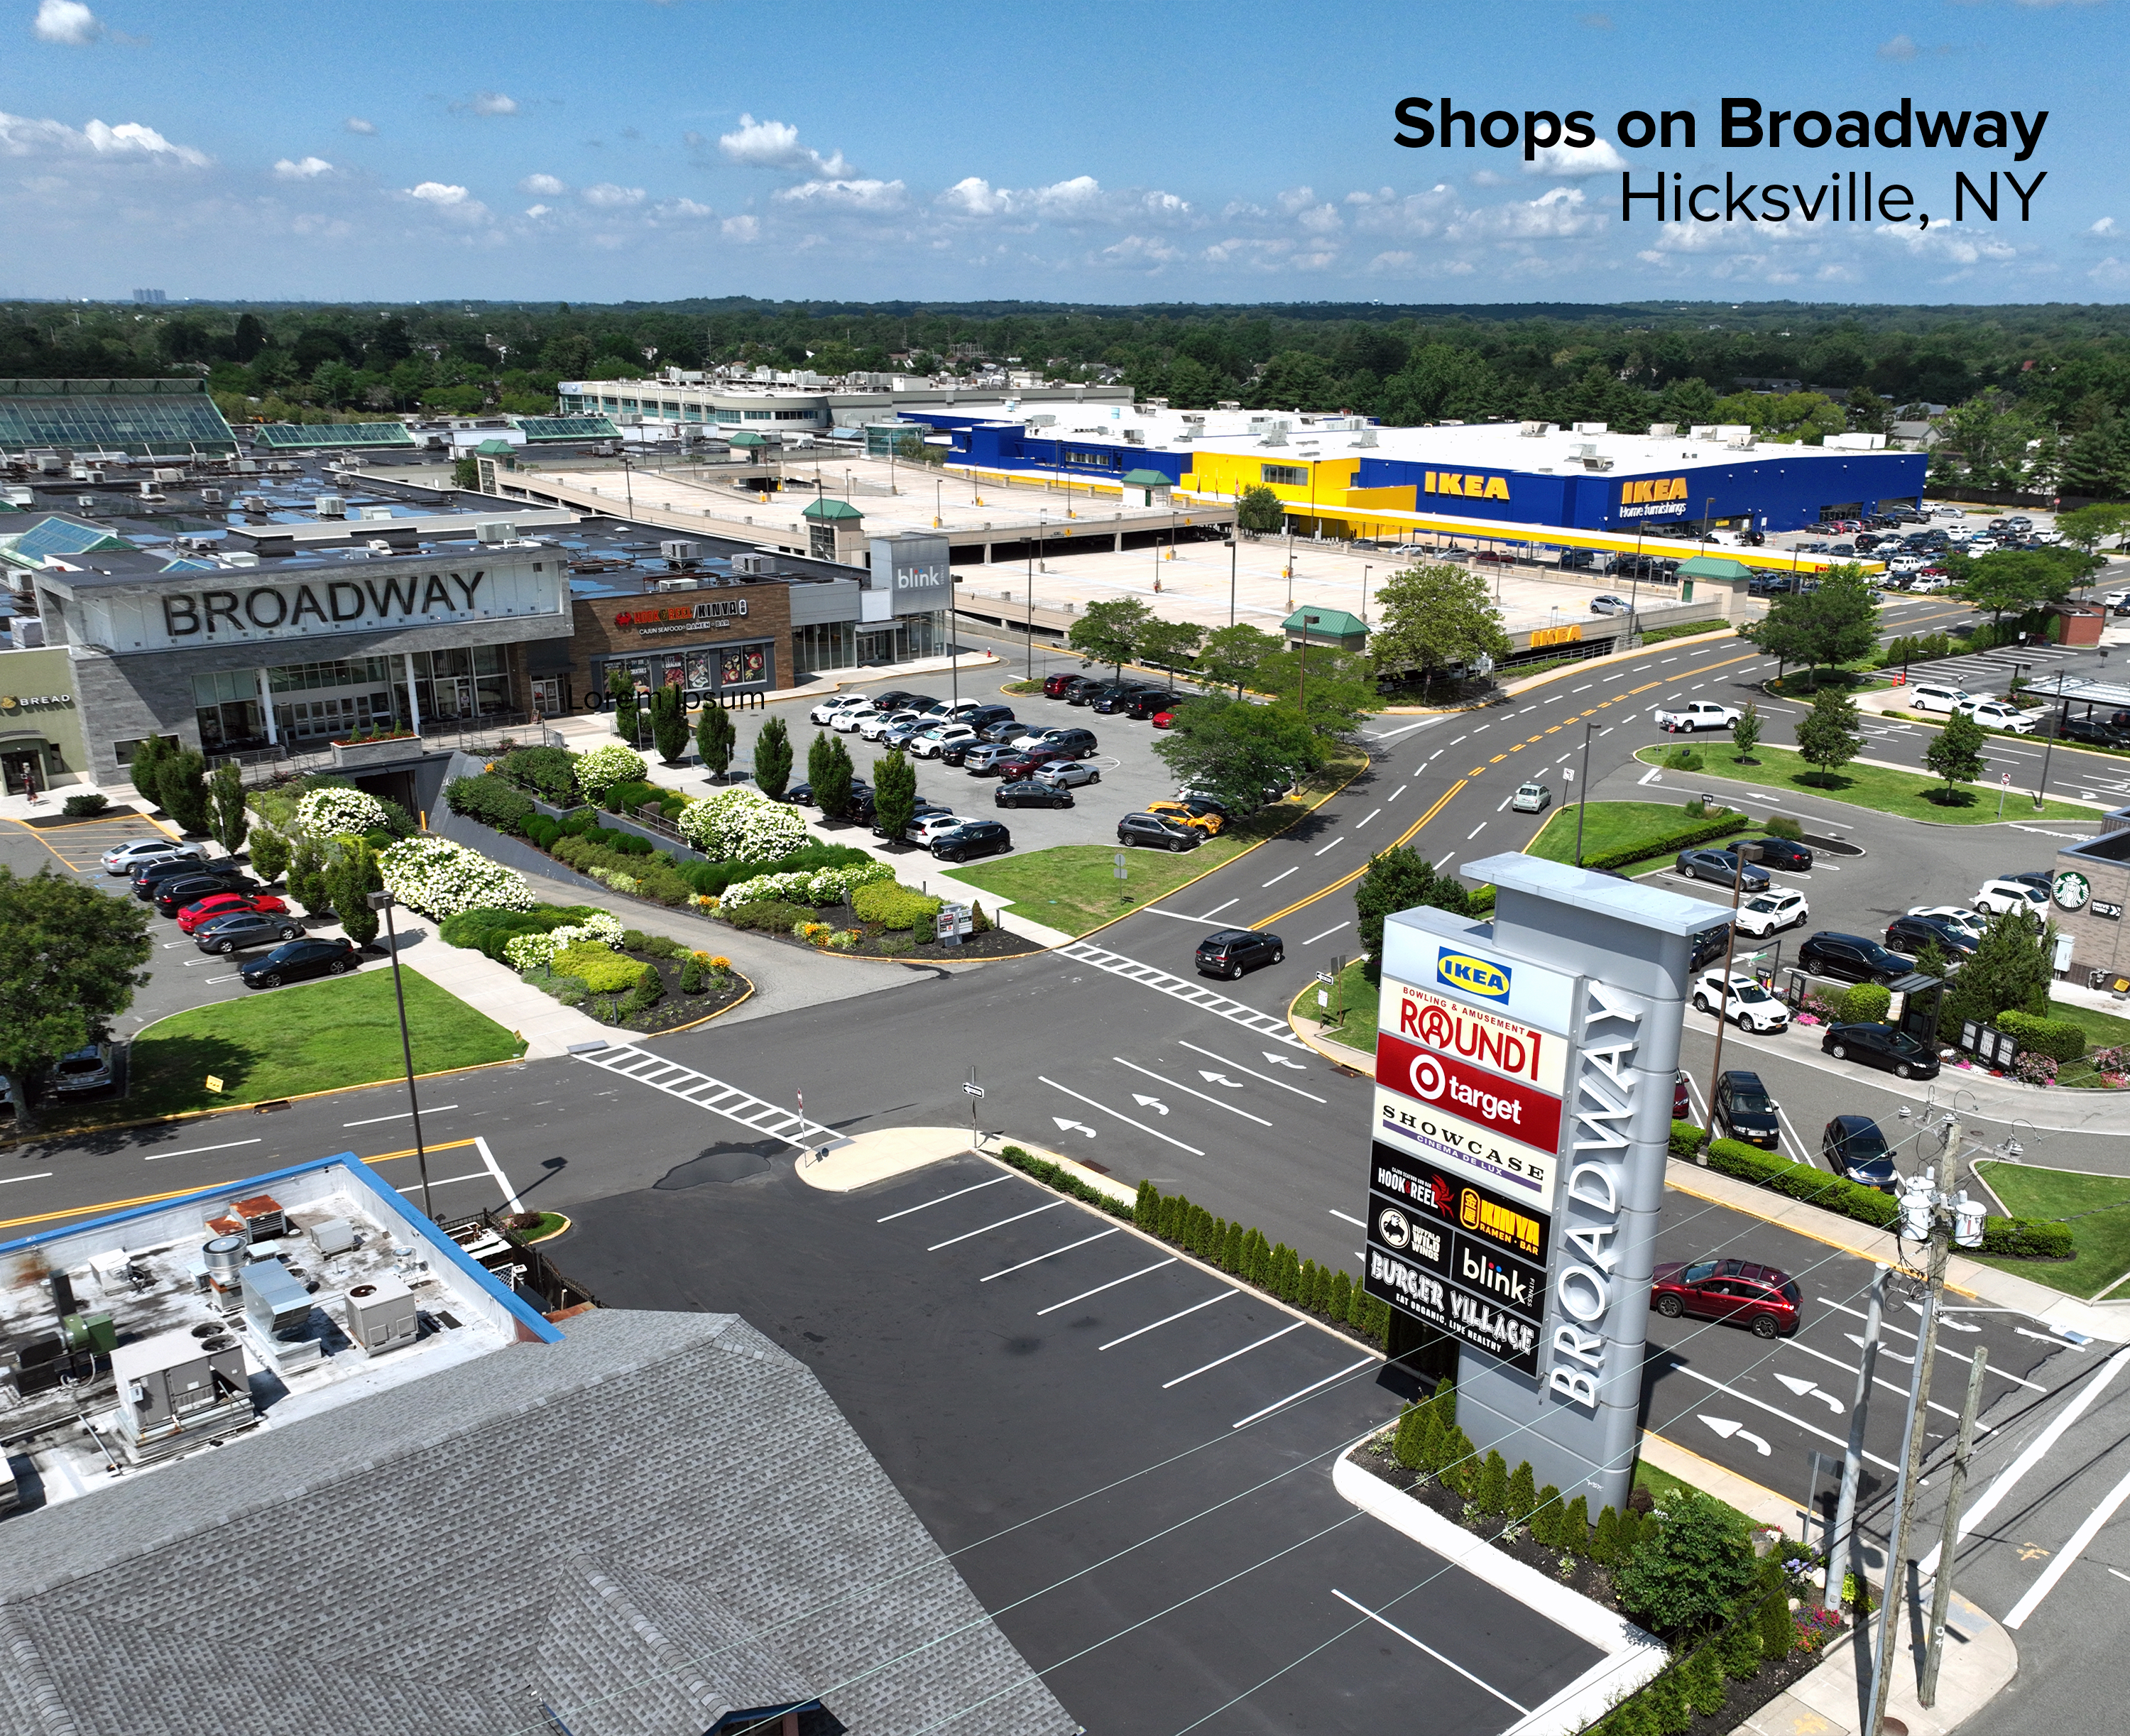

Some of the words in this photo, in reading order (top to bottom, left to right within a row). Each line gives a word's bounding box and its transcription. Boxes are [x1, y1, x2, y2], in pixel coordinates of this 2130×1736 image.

[1424, 471, 1510, 501] IKEA
[1621, 477, 1688, 505] IKEA
[1620, 506, 1644, 518] Home
[1644, 501, 1687, 516] furnishings
[897, 566, 940, 589] blink
[162, 571, 485, 637] BROADWAY
[686, 621, 710, 630] RAMEN
[715, 619, 730, 628] BAR
[1530, 625, 1583, 648] IKEA
[20, 694, 70, 706] BREAD
[2092, 901, 2110, 910] DRIVE
[1444, 959, 1504, 992] IKEA
[1403, 986, 1447, 1008] BOWLING
[1462, 1008, 1525, 1035] AMUSEMENT
[1449, 1076, 1522, 1125] target
[1382, 1104, 1544, 1181] SHOWCASE
[1416, 1135, 1459, 1157] CINEMA
[1462, 1154, 1477, 1165] DE
[1481, 1162, 1503, 1176] LUX
[1392, 1167, 1403, 1176] CAJUN
[1402, 1171, 1418, 1182] SEAFOOD
[1549, 978, 1643, 1410] BROADWAY
[1412, 1224, 1441, 1243] BUFFALO
[1480, 1199, 1540, 1248] KINYA
[1411, 1240, 1439, 1262] WINGS
[1412, 1230, 1441, 1253] WILD
[1480, 1223, 1512, 1244] RAMEN
[1519, 1240, 1539, 1256] BAR
[1463, 1248, 1527, 1304] blink
[1371, 1250, 1445, 1312] BURGER
[1451, 1290, 1534, 1355] VILLAGE
[1526, 1277, 1535, 1308] FITNESS
[1396, 1293, 1409, 1306] EAT
[1449, 1319, 1465, 1335] LIVE
[1468, 1329, 1502, 1353] HEALTHY
